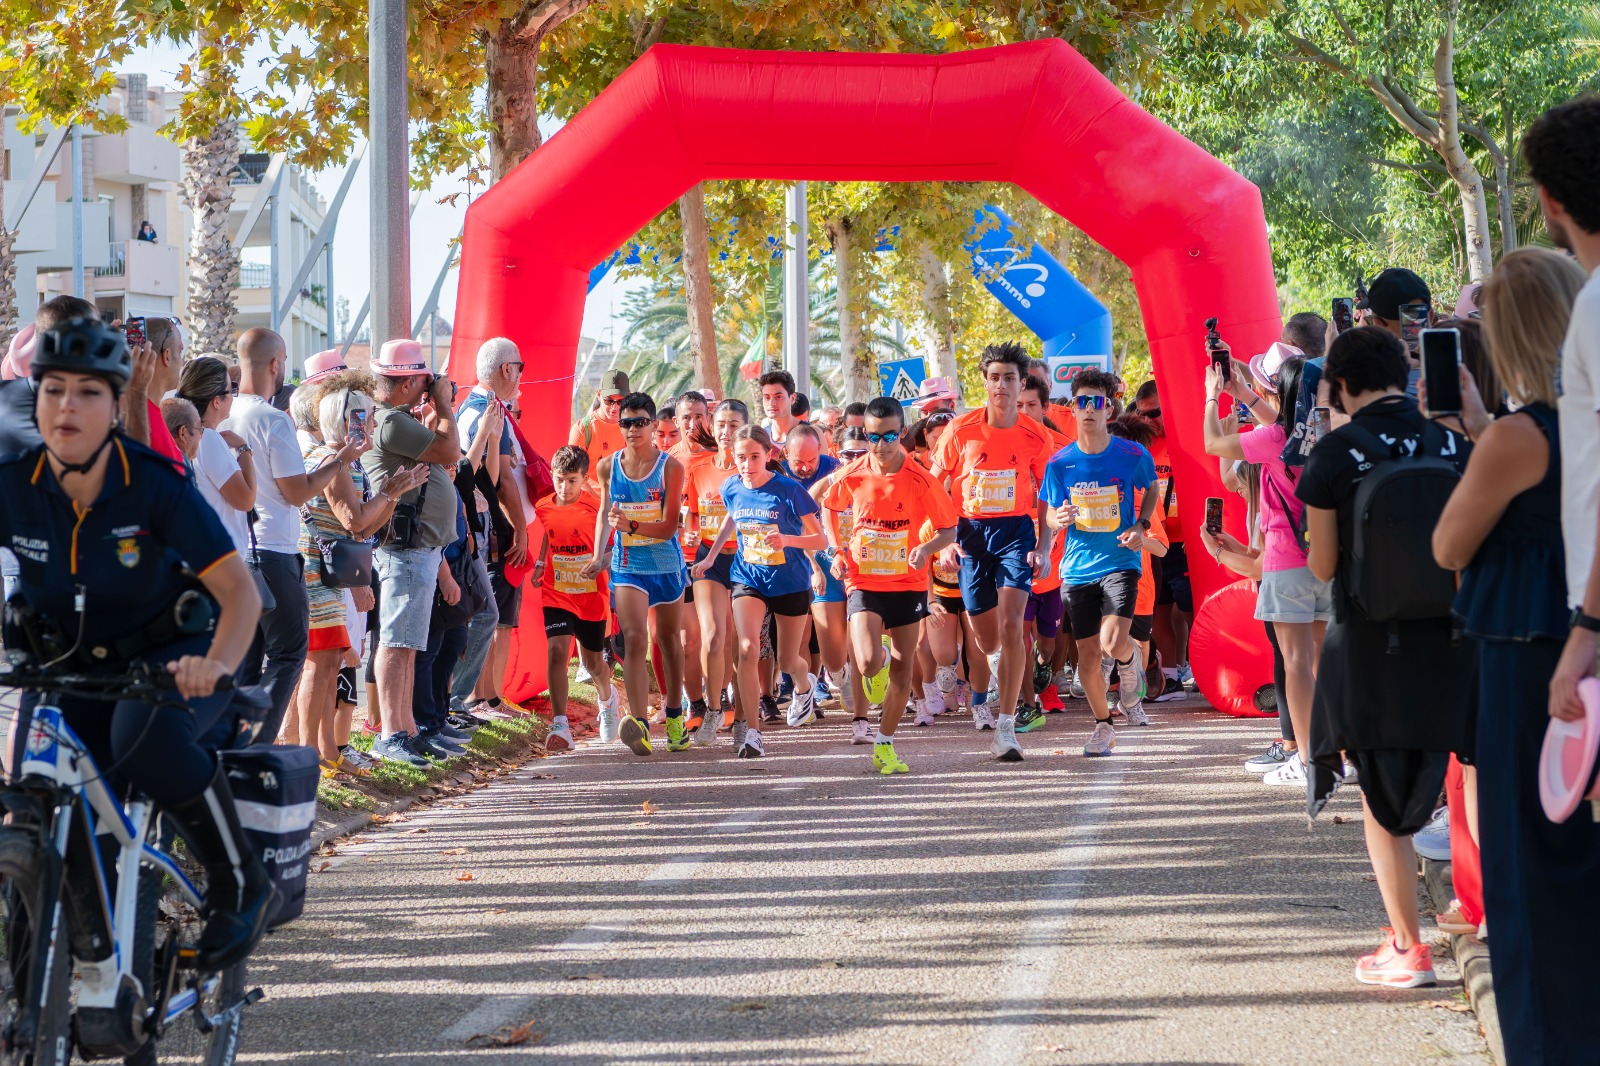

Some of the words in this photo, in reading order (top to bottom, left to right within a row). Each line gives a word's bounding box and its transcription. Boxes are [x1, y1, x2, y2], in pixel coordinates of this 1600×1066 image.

[1056, 366, 1099, 381] CR
[755, 509, 779, 519] ICHNOS
[1080, 505, 1111, 521] 3068
[868, 547, 899, 563] 3024
[561, 571, 587, 584] 302
